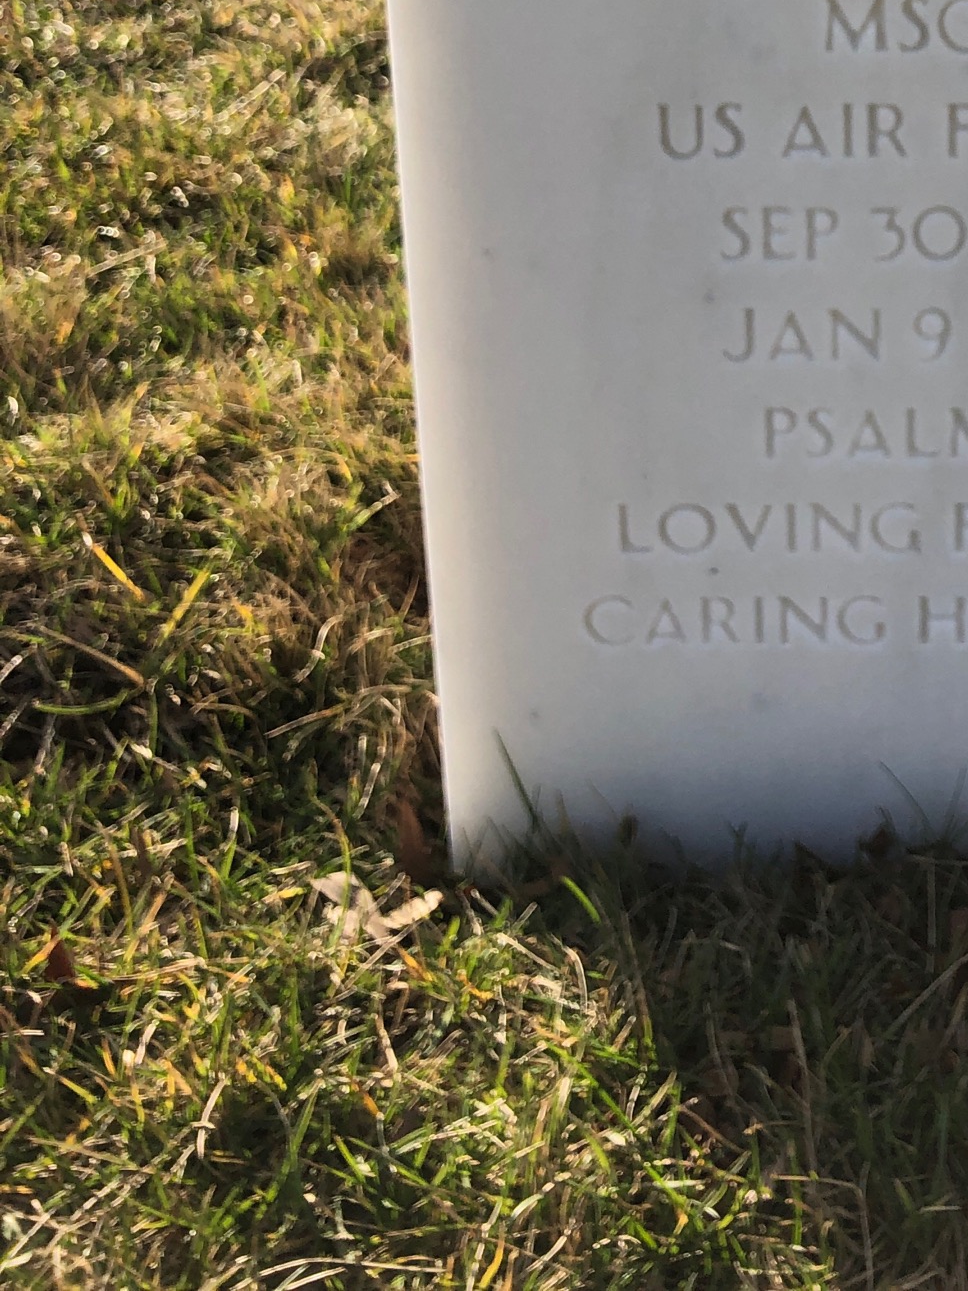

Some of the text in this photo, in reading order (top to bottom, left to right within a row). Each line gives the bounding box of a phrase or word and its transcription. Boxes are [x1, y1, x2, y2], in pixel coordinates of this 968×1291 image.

[657, 101, 746, 161] US
[780, 101, 908, 160] AIR
[719, 205, 840, 263] SEP
[870, 205, 968, 262] 30
[722, 307, 883, 364] JAN
[912, 306, 953, 362] 9
[616, 501, 923, 556] LOVING
[582, 593, 889, 646] CARING
